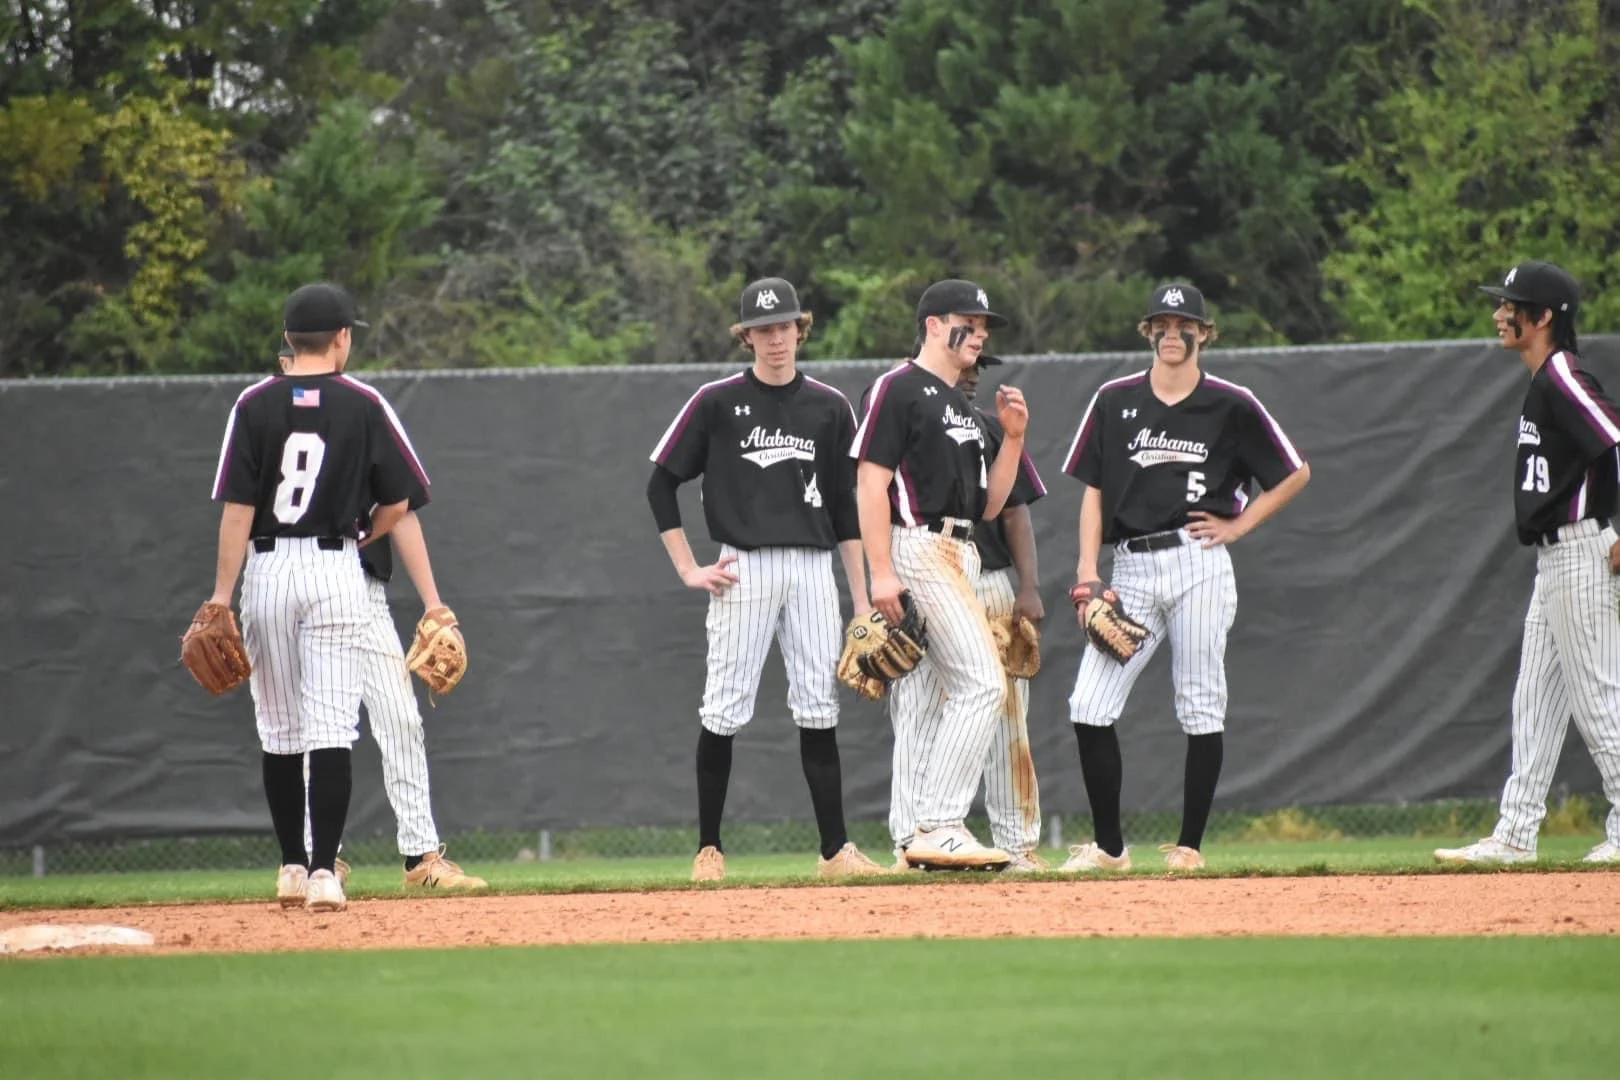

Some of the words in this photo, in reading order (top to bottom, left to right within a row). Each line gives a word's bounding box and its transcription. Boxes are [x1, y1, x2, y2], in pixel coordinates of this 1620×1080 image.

[1128, 427, 1206, 453] Alabama
[273, 432, 325, 524] 8
[1186, 471, 1207, 503] 5
[1521, 454, 1550, 493] 19
